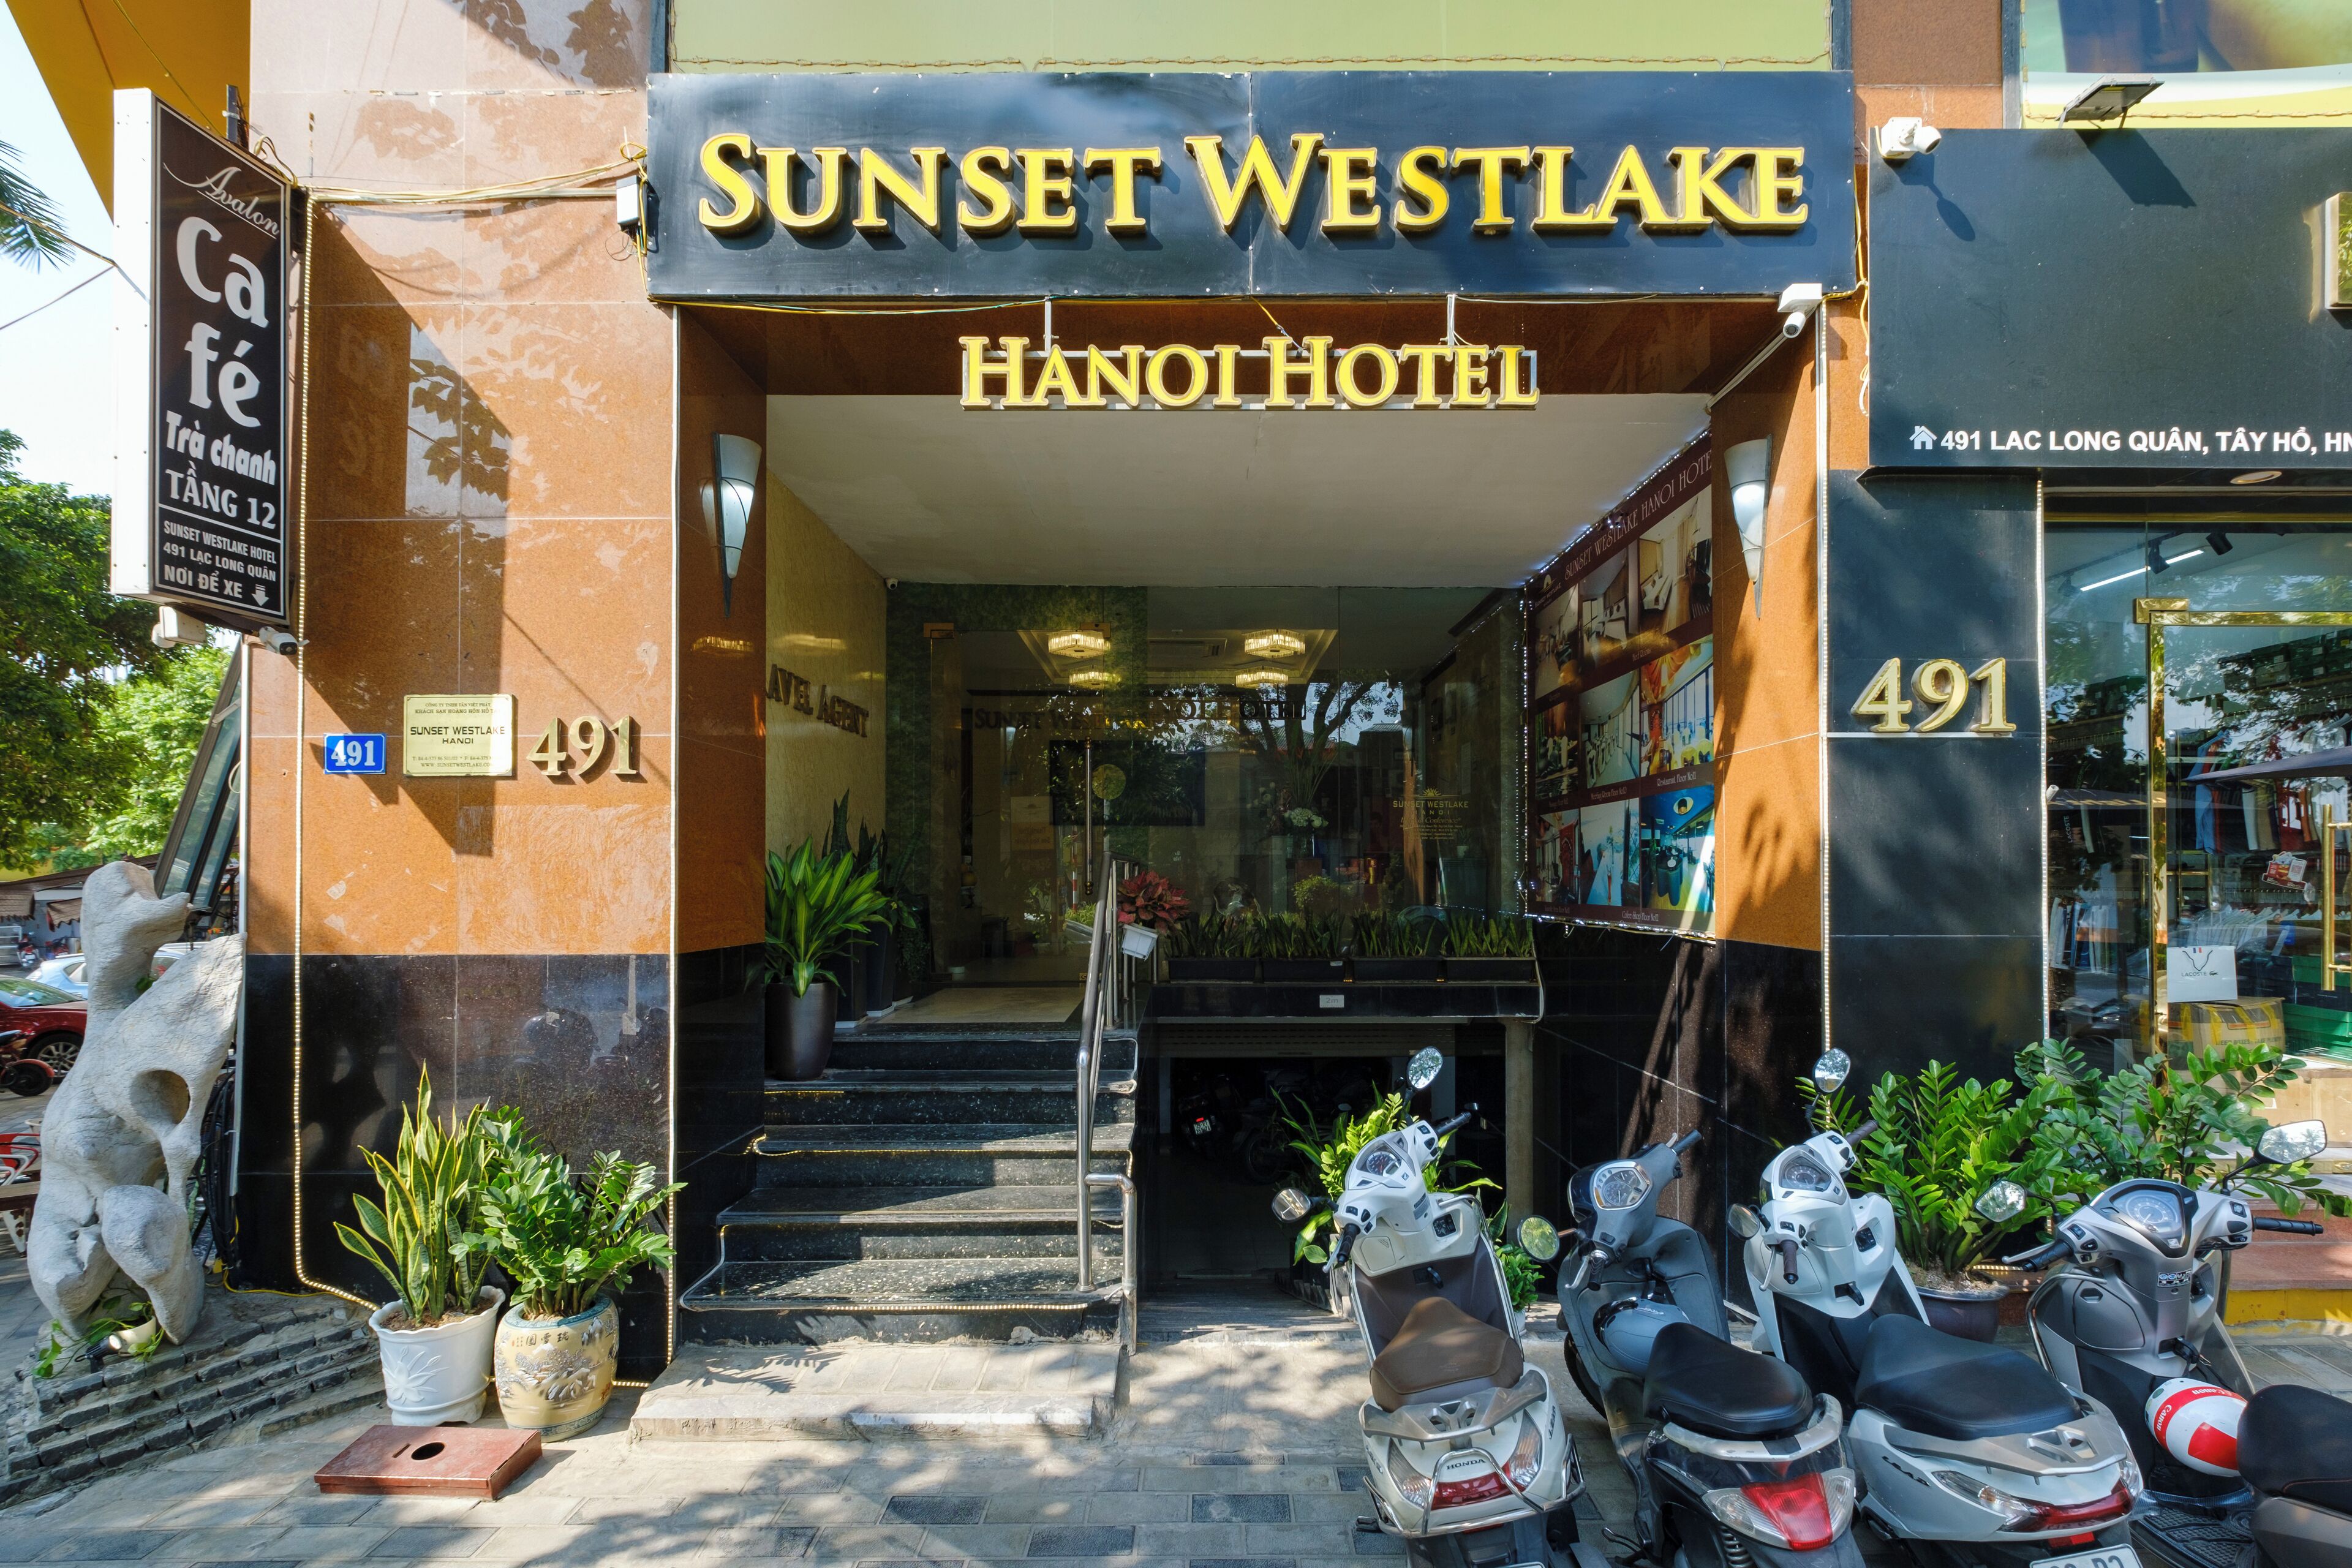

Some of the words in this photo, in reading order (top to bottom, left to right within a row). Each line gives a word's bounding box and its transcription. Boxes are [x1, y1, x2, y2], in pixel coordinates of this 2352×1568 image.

[163, 162, 279, 235] Avalon
[699, 133, 1163, 235] SUNSET
[1184, 132, 1808, 233] WESTLAKE
[177, 216, 269, 328] Ca
[184, 322, 261, 428] fé
[959, 336, 1242, 410] HANOI
[1262, 335, 1540, 410] HOTEL
[166, 410, 205, 460] Trà
[211, 434, 276, 485] chanh
[1940, 430, 1981, 451] 491
[1991, 431, 2041, 451] LAC
[2049, 430, 2120, 451] LONG
[2128, 427, 2209, 454] QUÂN,
[2215, 427, 2267, 451] TÂY
[165, 461, 238, 518] TẦNG
[247, 497, 276, 529] 12
[1564, 546, 1592, 581] SUNSET
[1594, 510, 1638, 557] WESTLAKE
[1641, 480, 1675, 521] HANOI
[1679, 450, 1711, 492] HOTE
[164, 520, 200, 542] SUNSET
[202, 532, 249, 556] WESTLAKE
[250, 546, 277, 564] HOTEL
[164, 542, 186, 558] 491
[190, 549, 212, 565] LẠC
[215, 555, 244, 574] LONG
[247, 564, 276, 582] QUÂN
[164, 565, 193, 586] NƠI
[197, 570, 219, 593] ĐỂ
[223, 579, 243, 598] XE
[766, 664, 814, 715] AVEL
[1851, 657, 2016, 733] 491
[331, 740, 376, 766] 491
[410, 726, 449, 736] SUNSET
[453, 726, 505, 735] WESTLAKE
[527, 715, 638, 777] 491
[2063, 815, 2073, 843] LACOSTE
[2157, 1404, 2173, 1431] Canon
[1446, 1458, 1486, 1470] HONDA
